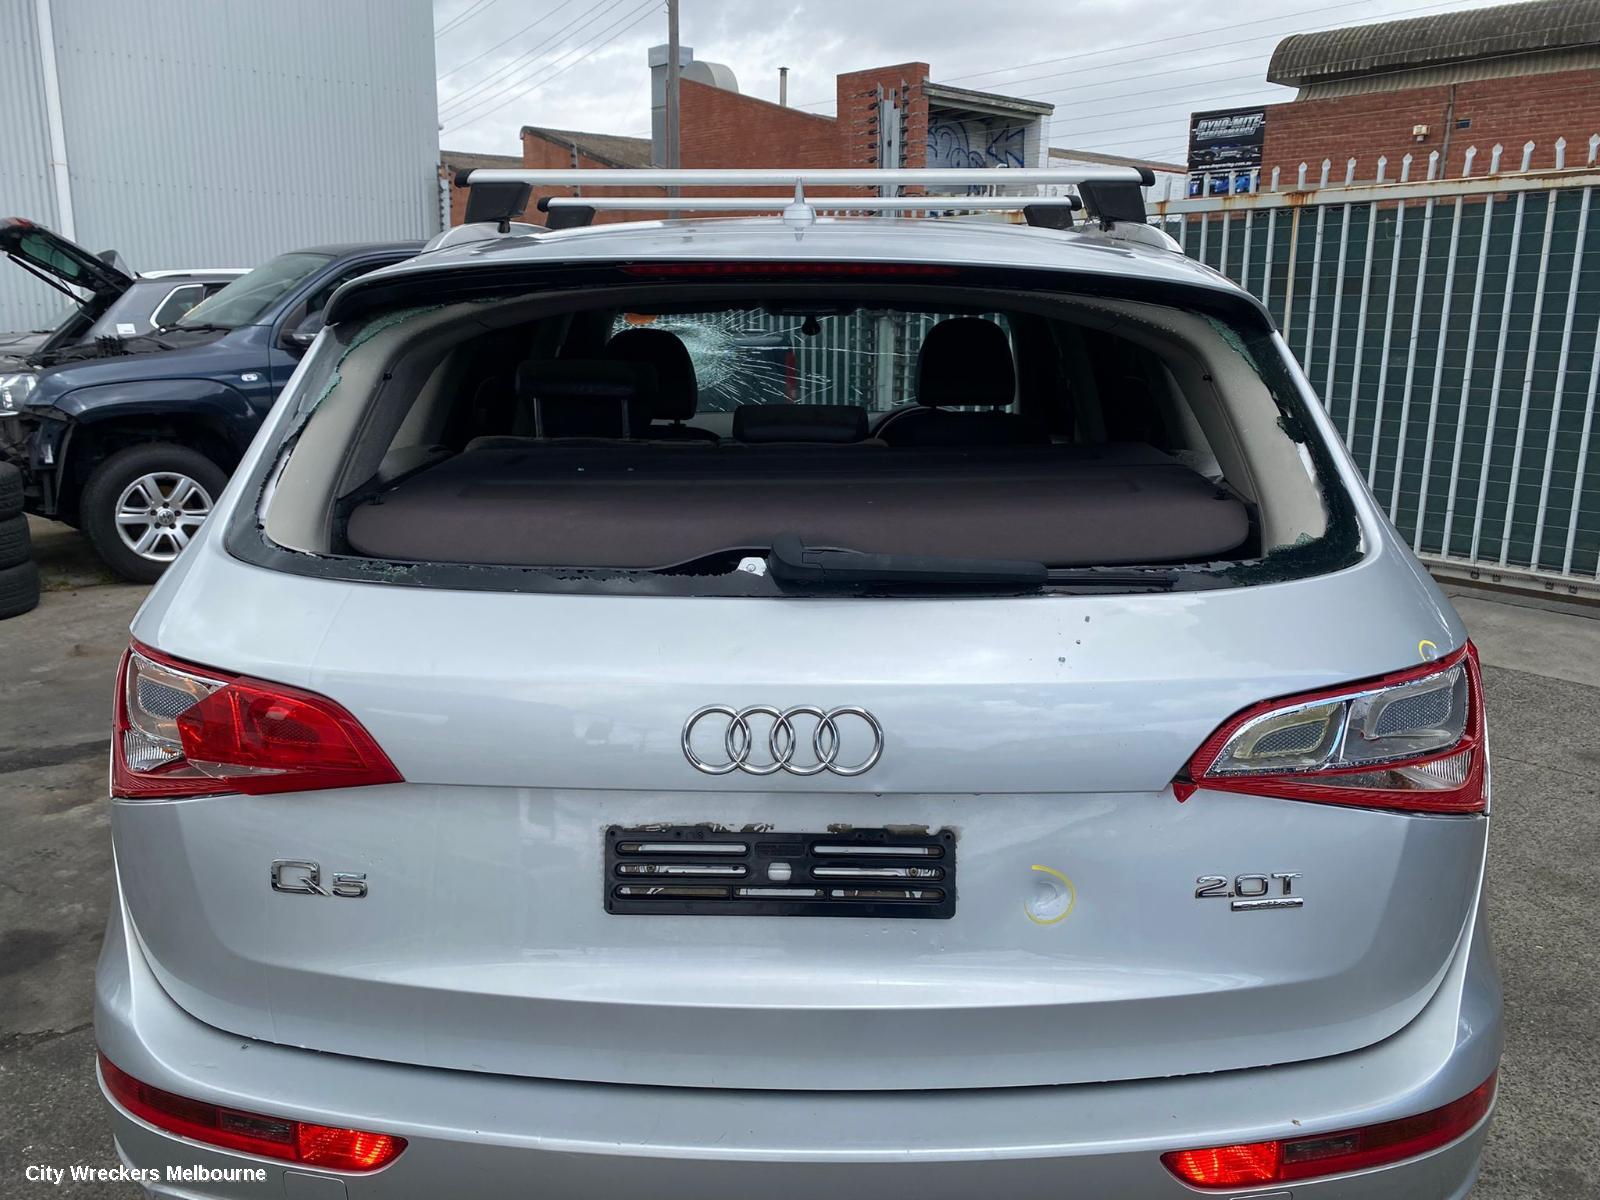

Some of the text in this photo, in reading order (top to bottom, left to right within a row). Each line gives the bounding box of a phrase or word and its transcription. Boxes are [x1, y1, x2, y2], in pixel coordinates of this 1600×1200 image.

[1197, 115, 1262, 132] DYNO-MITE
[1199, 127, 1256, 138] PERFORMANCE
[271, 858, 368, 898] Q5
[1195, 872, 1303, 899] 2.0T
